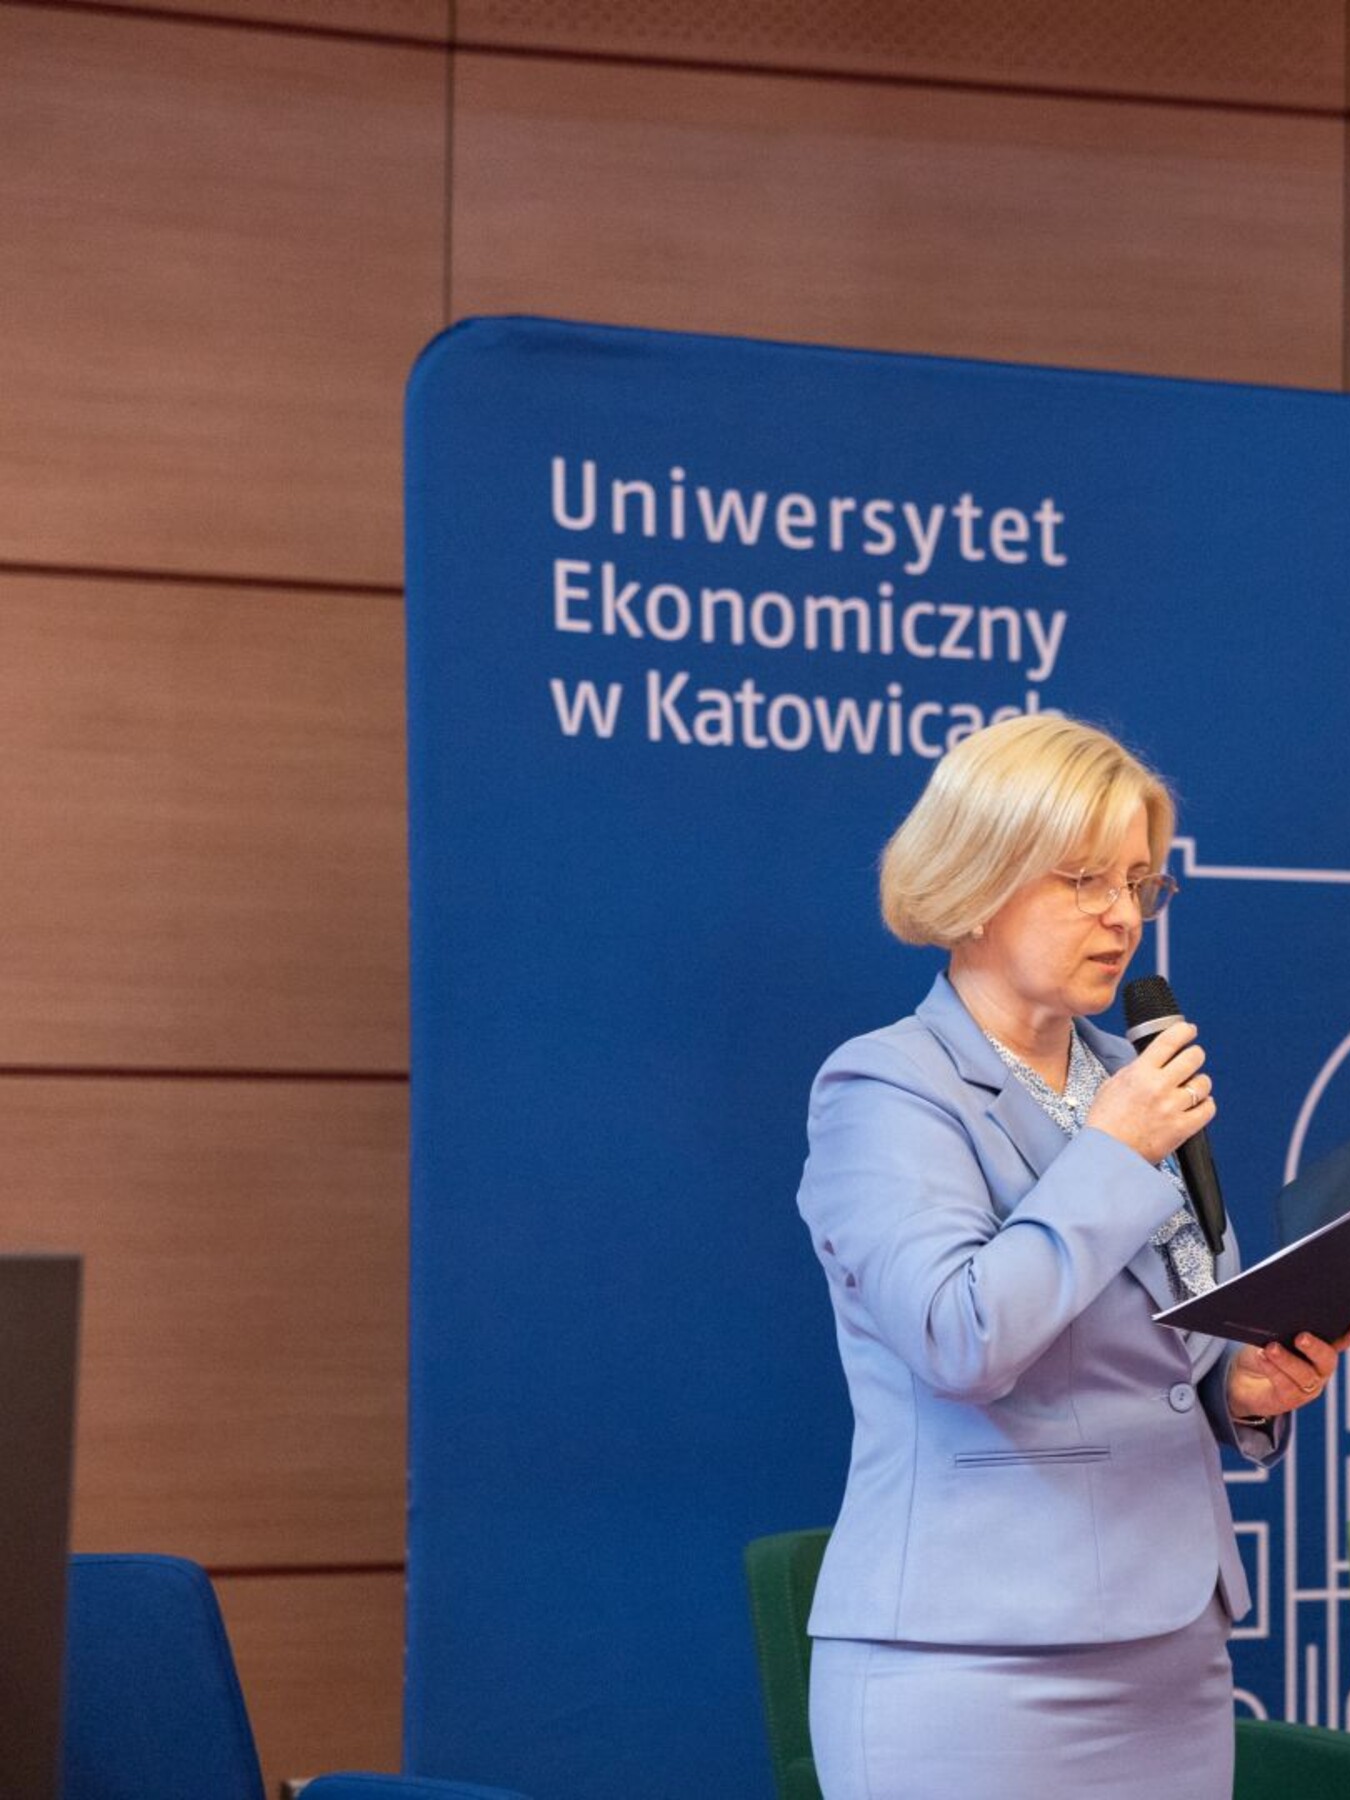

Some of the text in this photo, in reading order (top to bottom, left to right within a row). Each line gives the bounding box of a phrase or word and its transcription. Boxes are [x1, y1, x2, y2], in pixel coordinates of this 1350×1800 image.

[552, 456, 1067, 575] Uniwersytet
[554, 558, 1067, 682] Ekonomiczny
[550, 669, 1068, 759] w Katowica
